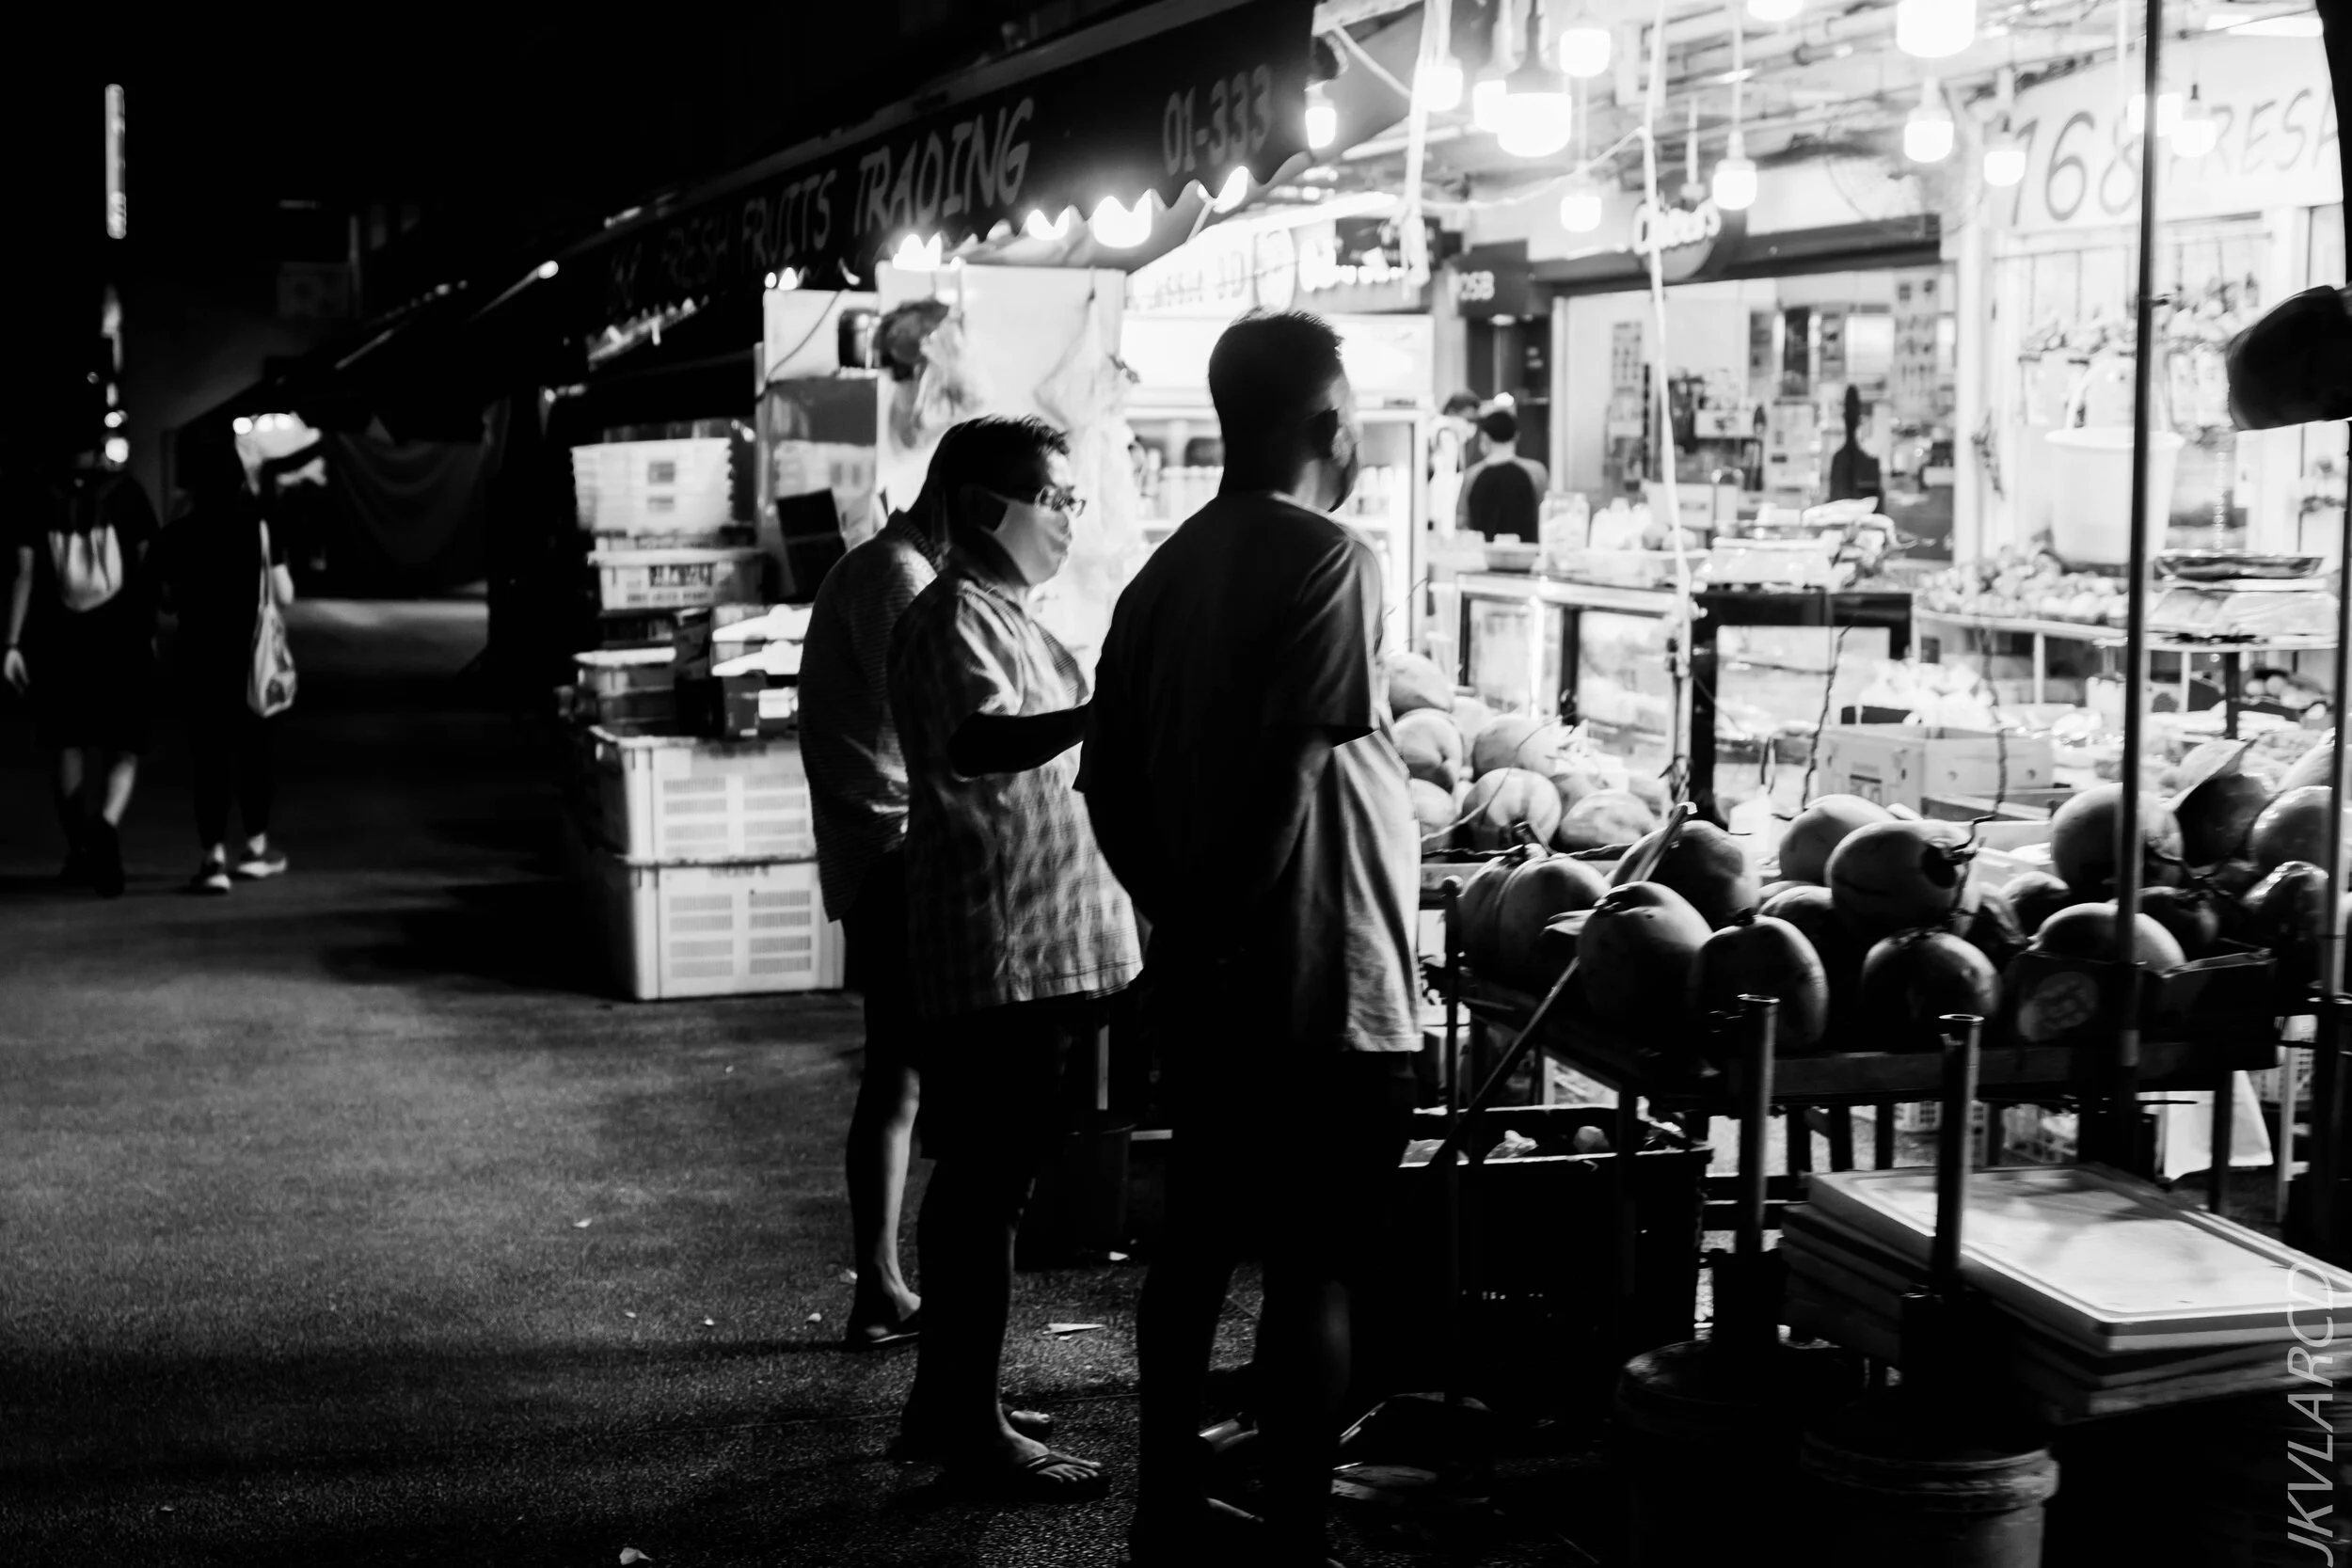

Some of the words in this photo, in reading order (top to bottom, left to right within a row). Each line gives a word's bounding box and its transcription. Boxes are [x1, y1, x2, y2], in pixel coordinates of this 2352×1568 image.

[740, 167, 838, 277] FRUITS
[852, 97, 1034, 237] TRADING
[1163, 63, 1272, 178] 01-333
